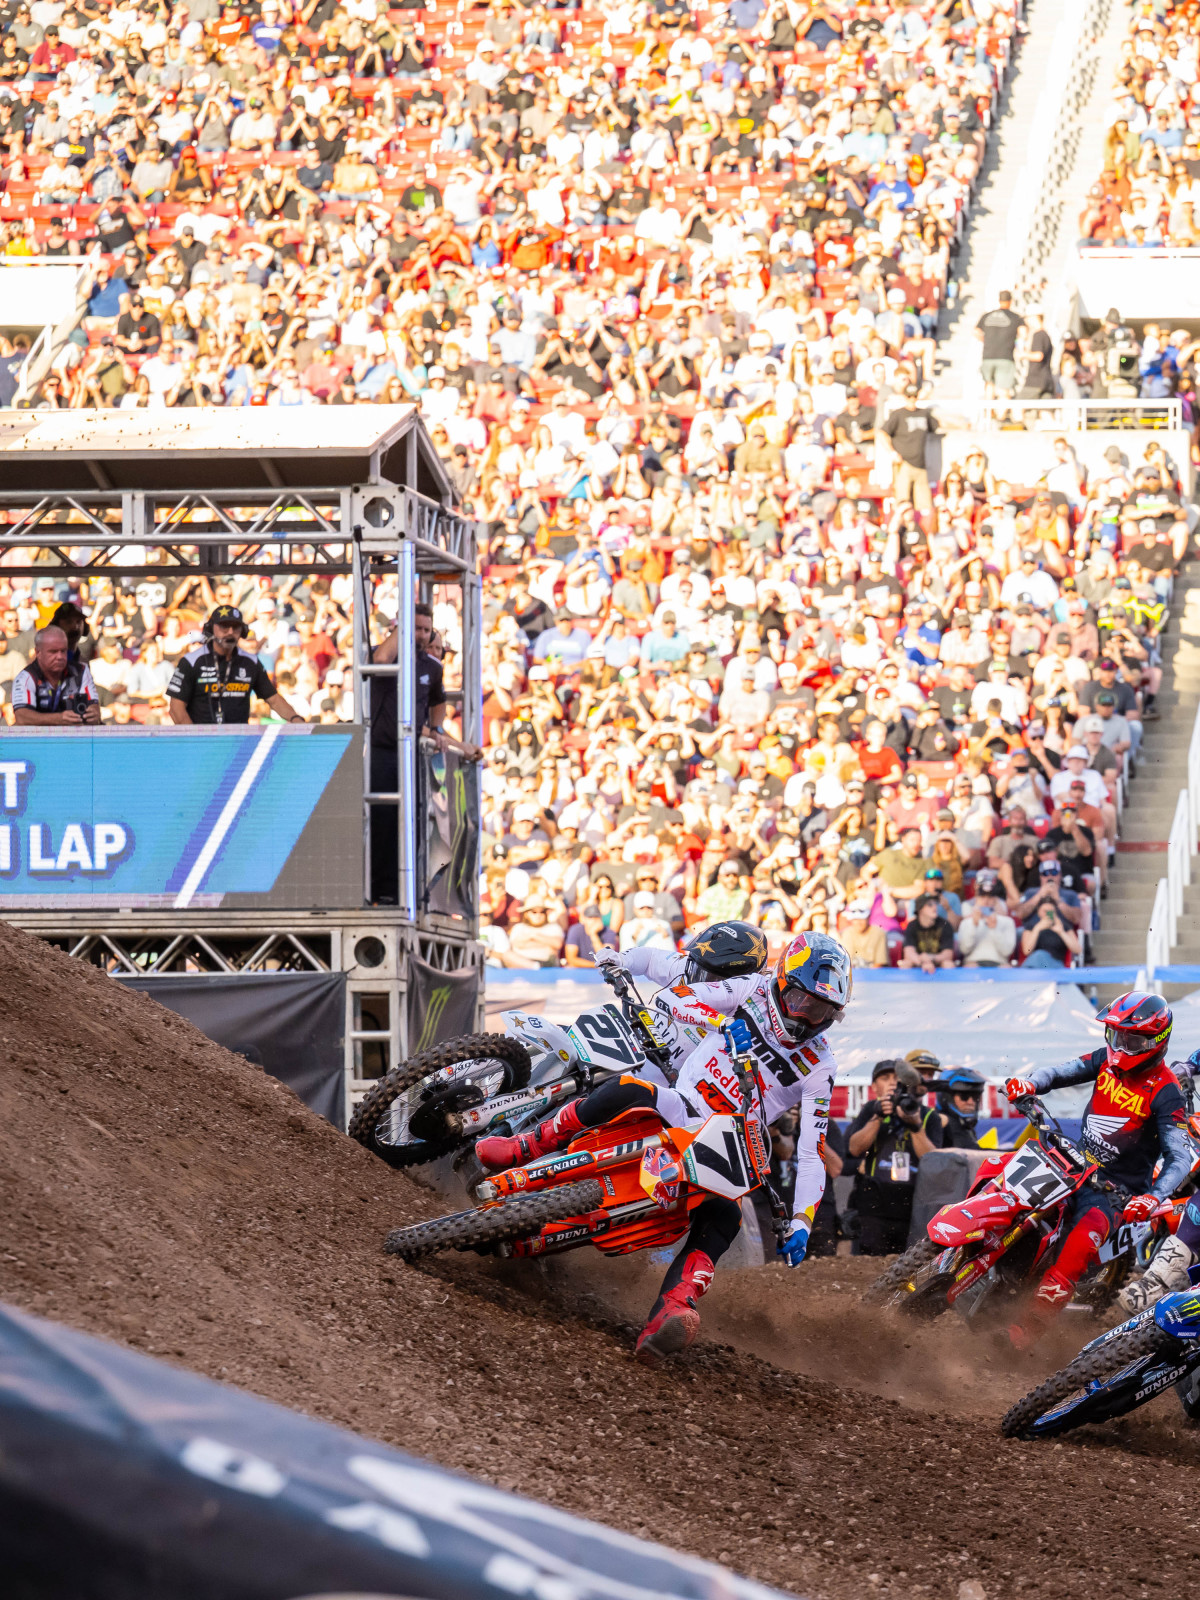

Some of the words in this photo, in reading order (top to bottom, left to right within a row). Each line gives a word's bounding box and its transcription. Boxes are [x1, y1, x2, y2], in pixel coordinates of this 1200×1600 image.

[0, 762, 27, 808] T
[29, 824, 127, 870] LAP
[575, 1013, 637, 1064] 27
[672, 1006, 689, 1022] Red
[689, 1012, 707, 1028] Bull
[704, 1056, 735, 1089] Red
[1096, 1072, 1147, 1117] O'NEAL
[691, 1131, 747, 1187] 7
[748, 1125, 763, 1170] RENTHAL
[1081, 1126, 1121, 1155] HONDA
[1006, 1155, 1061, 1208] 14
[555, 1222, 606, 1243] DUNLP
[1108, 1225, 1134, 1257] 14
[1134, 1364, 1188, 1400] DUNLOP
